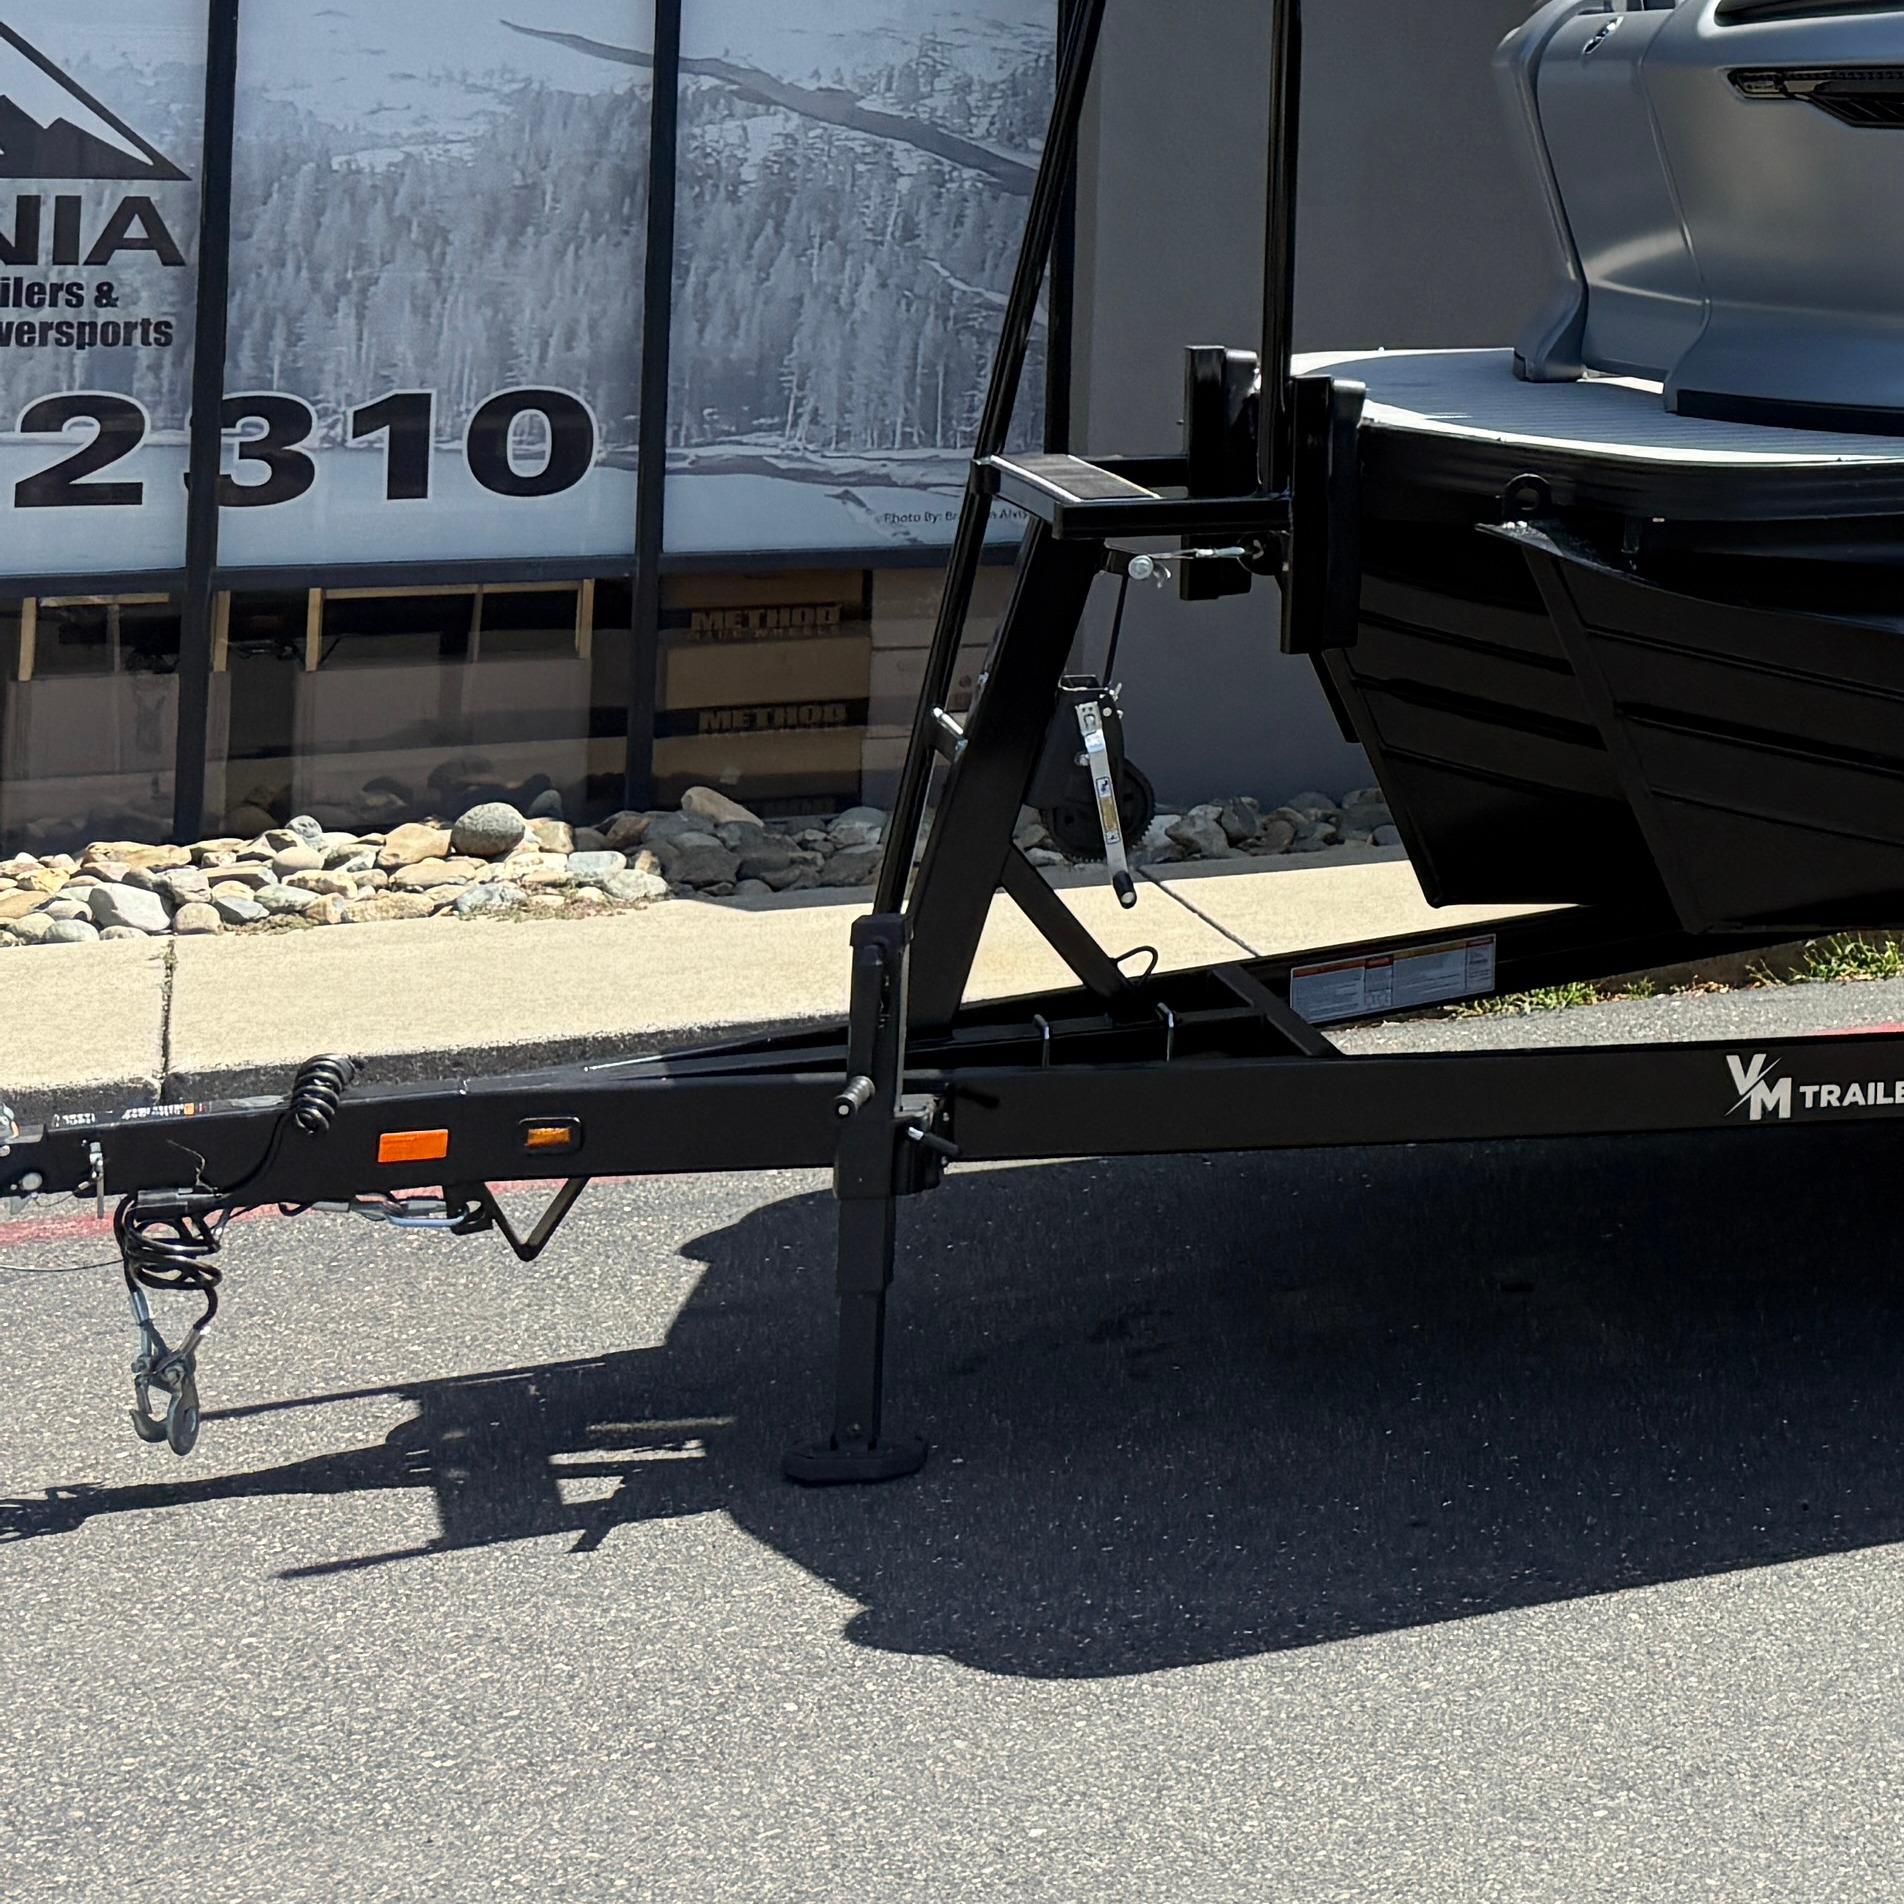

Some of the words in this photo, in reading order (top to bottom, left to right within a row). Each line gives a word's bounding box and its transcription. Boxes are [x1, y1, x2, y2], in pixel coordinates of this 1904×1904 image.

[91, 279, 119, 308] &
[691, 605, 842, 630] METHOD
[699, 703, 848, 732] METHOD
